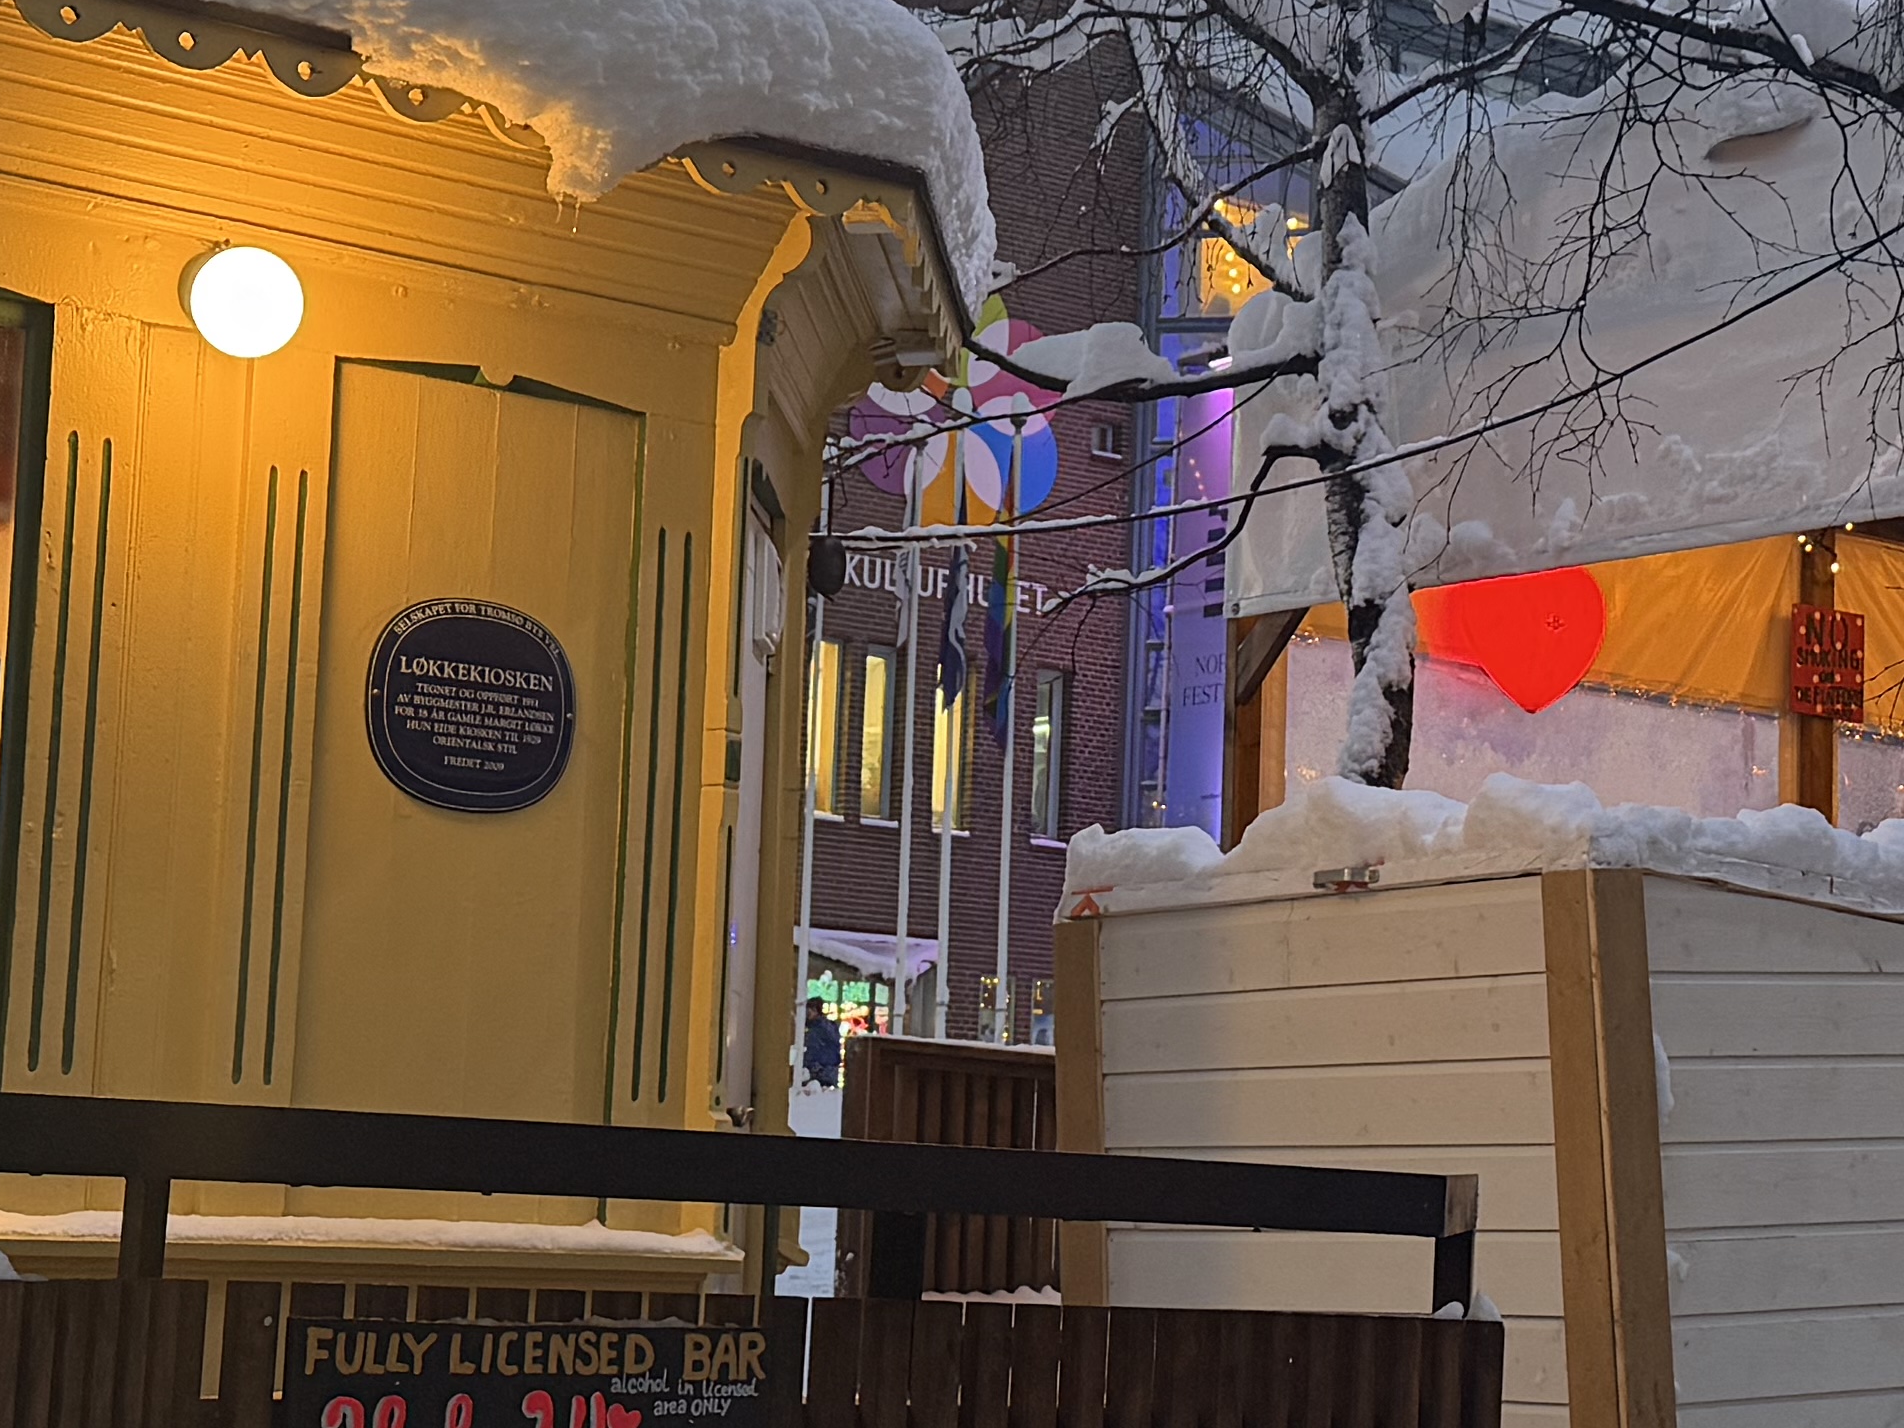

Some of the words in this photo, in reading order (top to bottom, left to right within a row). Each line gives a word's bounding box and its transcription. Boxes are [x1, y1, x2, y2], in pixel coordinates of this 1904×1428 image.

[394, 604, 452, 635] SELSKAPET
[455, 603, 476, 614] FOR
[1806, 612, 1849, 651] NO
[399, 655, 553, 692] LØKKEKIOSKEN
[416, 682, 456, 697] TEGNET
[459, 687, 475, 699] OG
[397, 693, 411, 704] AV
[413, 694, 479, 713] BYGGMESTER
[395, 706, 415, 717] FOR
[431, 708, 445, 721] ÅR
[447, 711, 482, 725] GAMLE
[484, 716, 523, 731] MARGIT
[406, 719, 431, 732] HUN
[459, 726, 501, 740] KIOSKEN
[503, 730, 519, 743] TIL
[432, 735, 495, 751] ORIENTALSK
[497, 743, 518, 755] STIL
[443, 756, 481, 769] FREDET
[303, 1327, 439, 1377] FULLY
[448, 1331, 656, 1376] LICENSED
[682, 1332, 767, 1382] BAR
[610, 1368, 670, 1394] alcohol
[677, 1378, 694, 1396] in
[653, 1399, 687, 1416] area
[690, 1397, 732, 1417] ONLY
